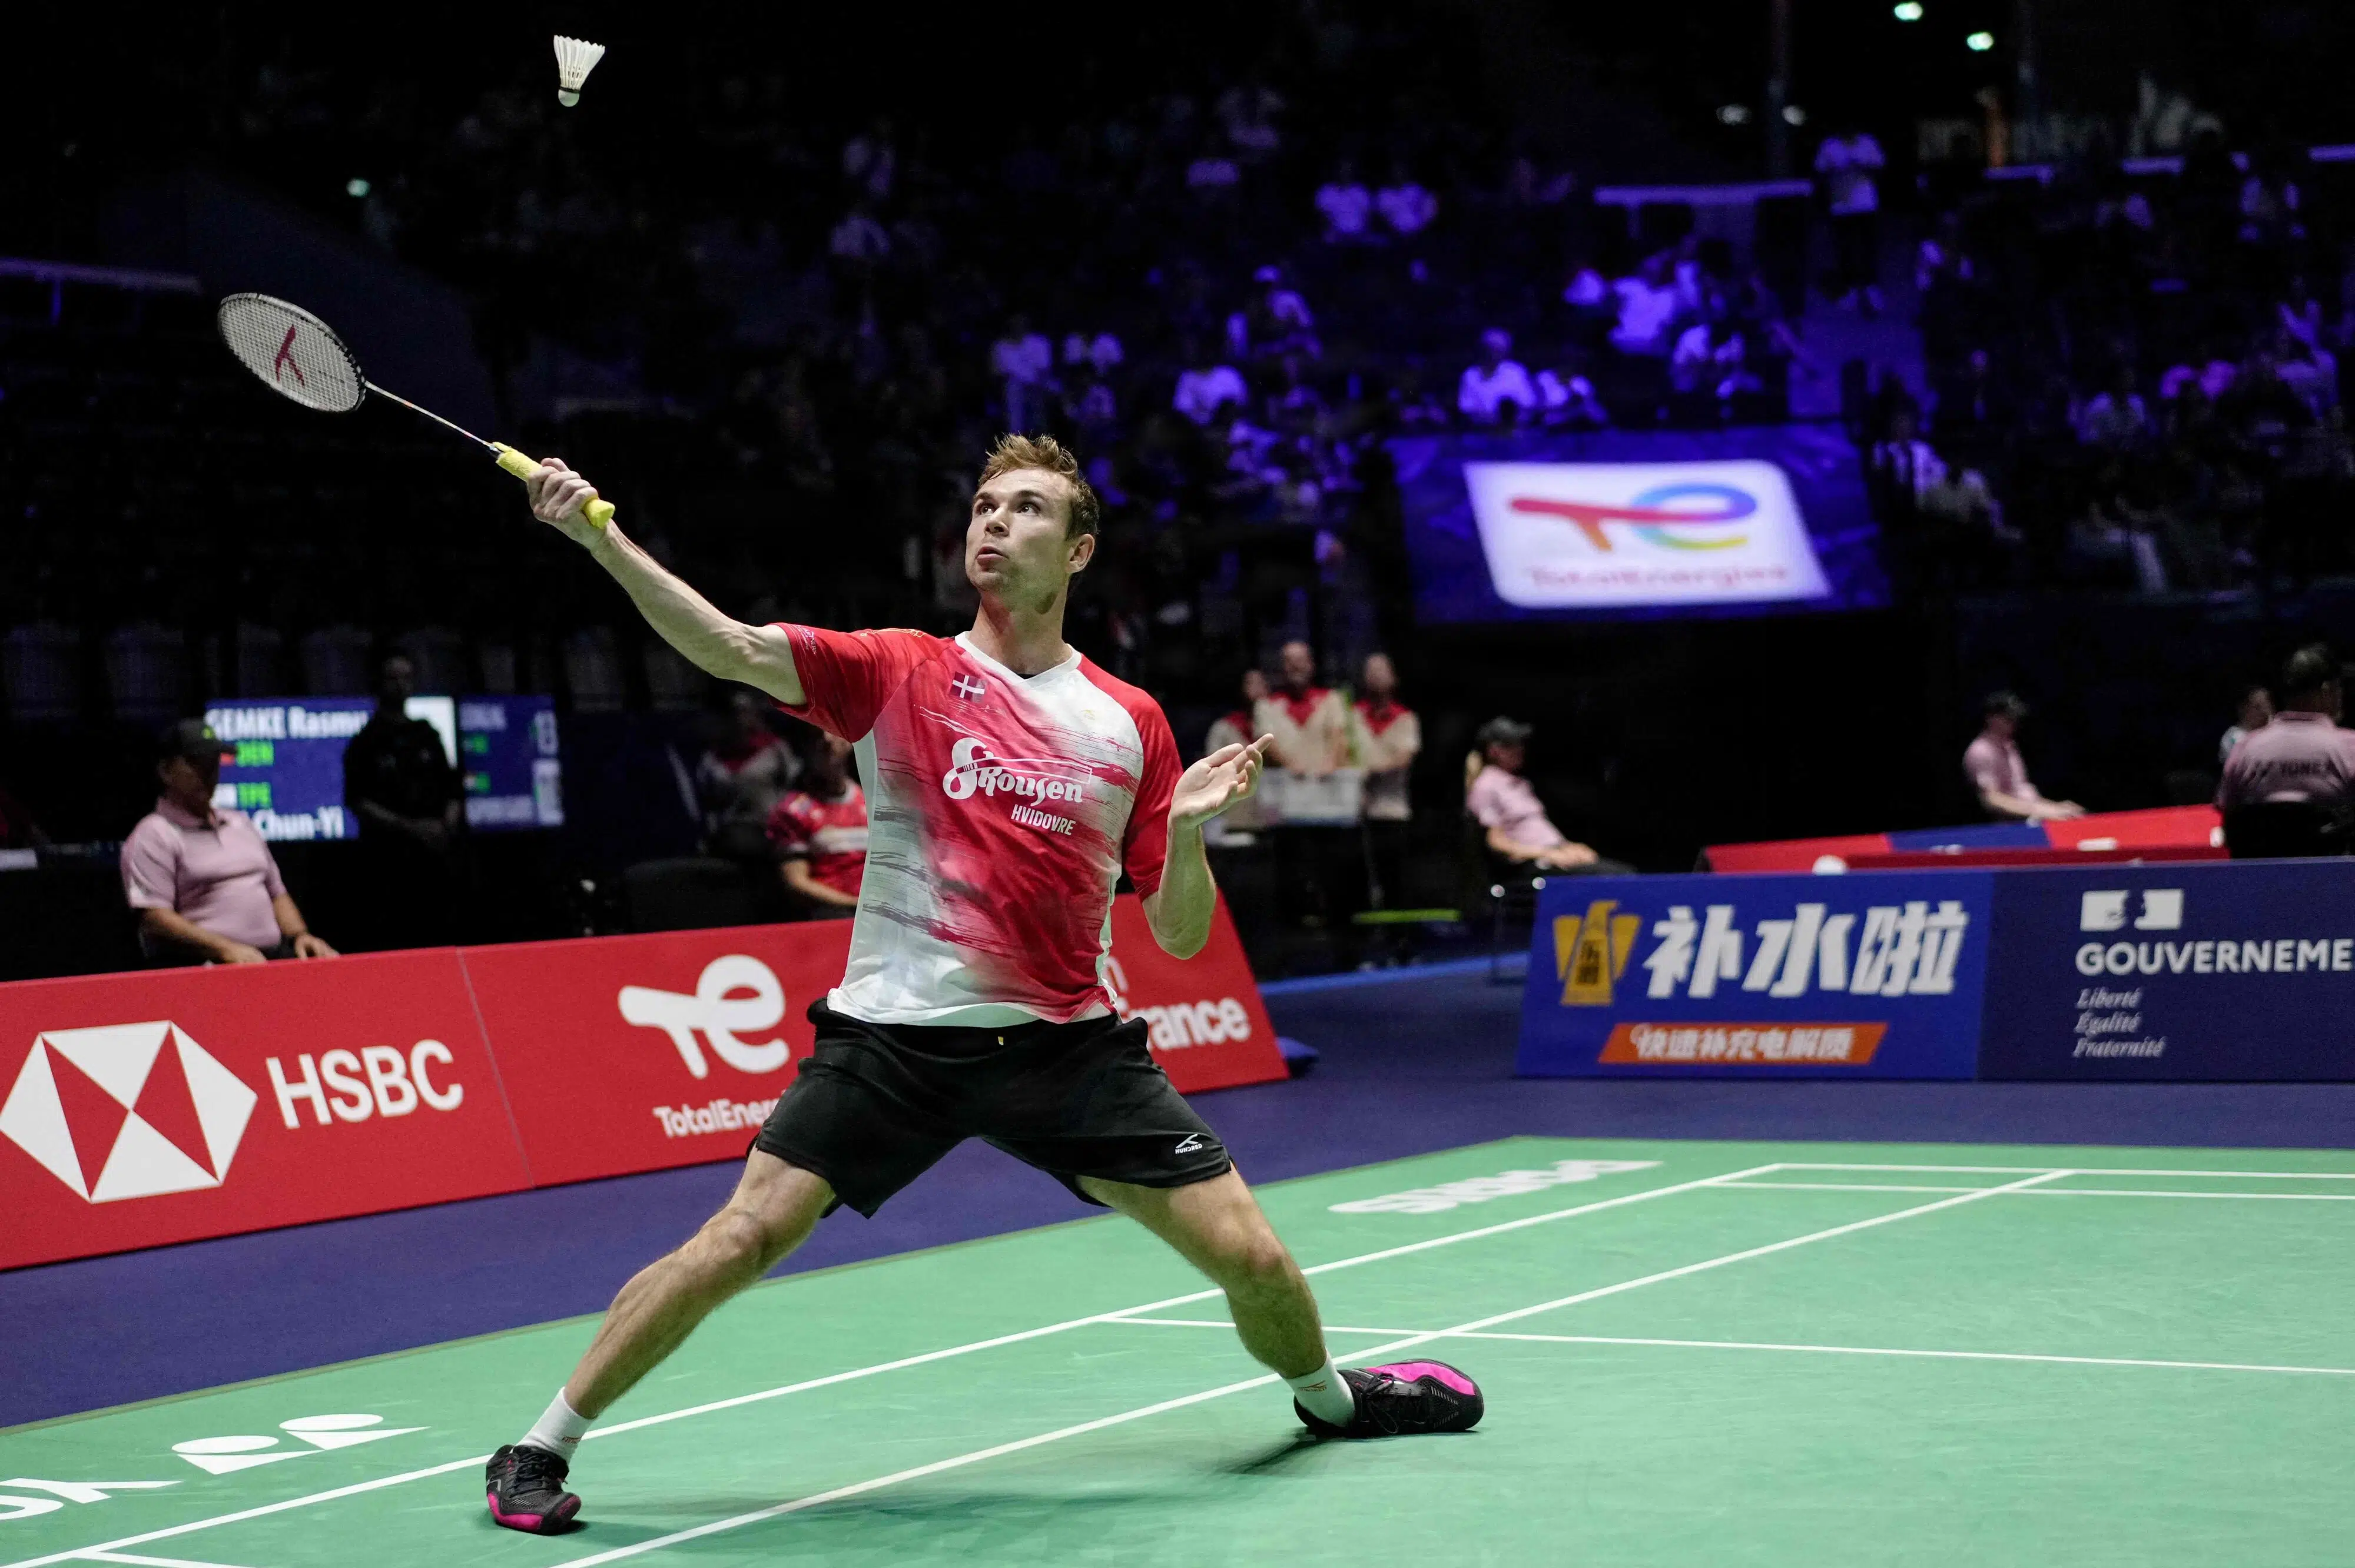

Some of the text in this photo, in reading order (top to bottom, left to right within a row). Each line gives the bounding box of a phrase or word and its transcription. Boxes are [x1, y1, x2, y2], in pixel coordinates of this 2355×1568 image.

[1010, 804, 1076, 836] HVIDOVRE
[1642, 901, 1970, 999] 补水啦
[2075, 938, 2354, 976] GOUVERNEME
[266, 1038, 463, 1130] HSBC
[653, 1089, 787, 1139] TotalEner
